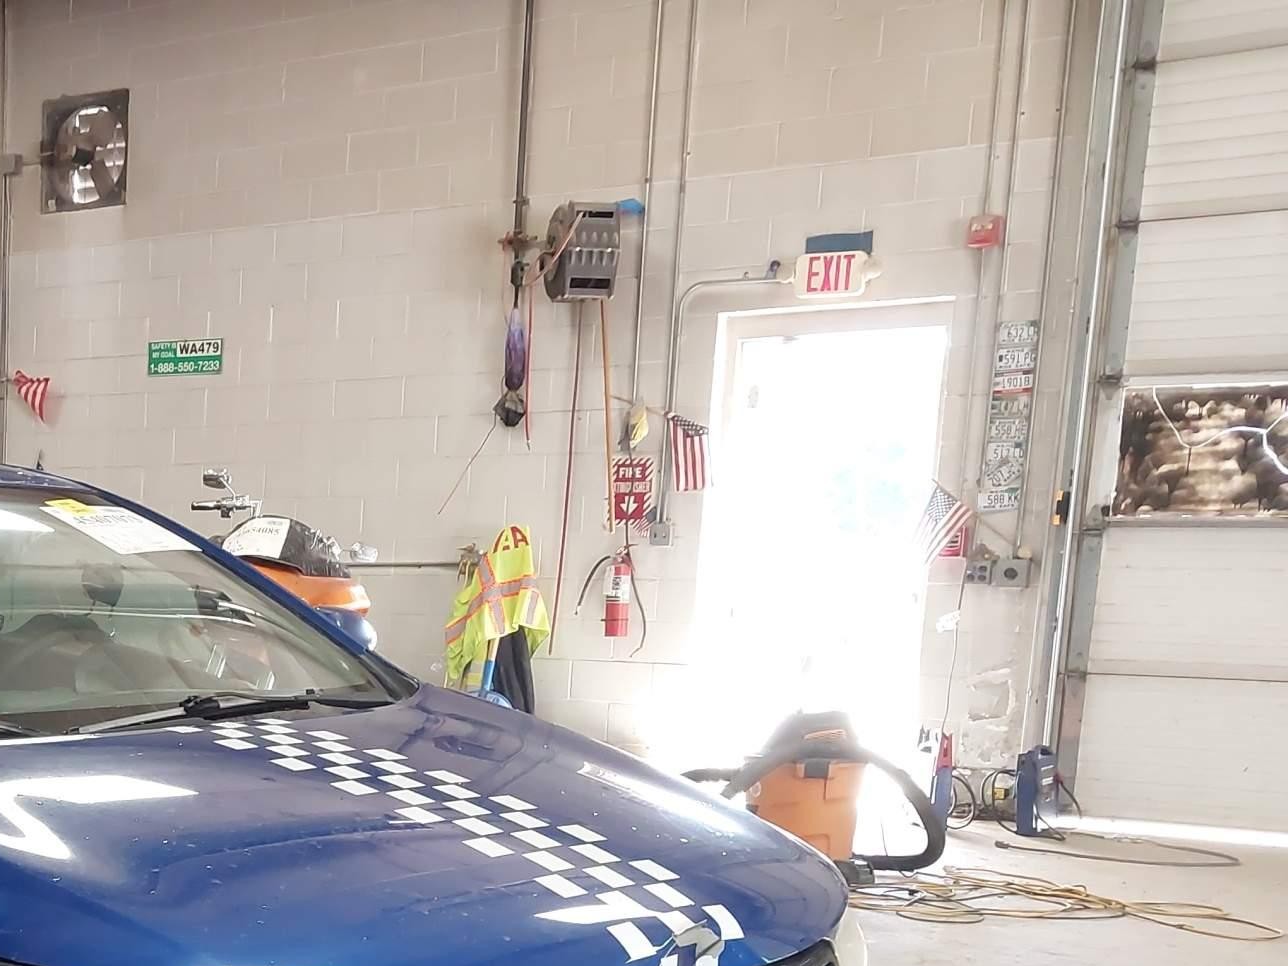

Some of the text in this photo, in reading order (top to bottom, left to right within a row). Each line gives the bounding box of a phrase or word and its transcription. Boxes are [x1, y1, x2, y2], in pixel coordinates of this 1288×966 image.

[807, 254, 856, 292] EXIT
[179, 341, 220, 355] WA479
[150, 360, 220, 373] 1-888-550-7233
